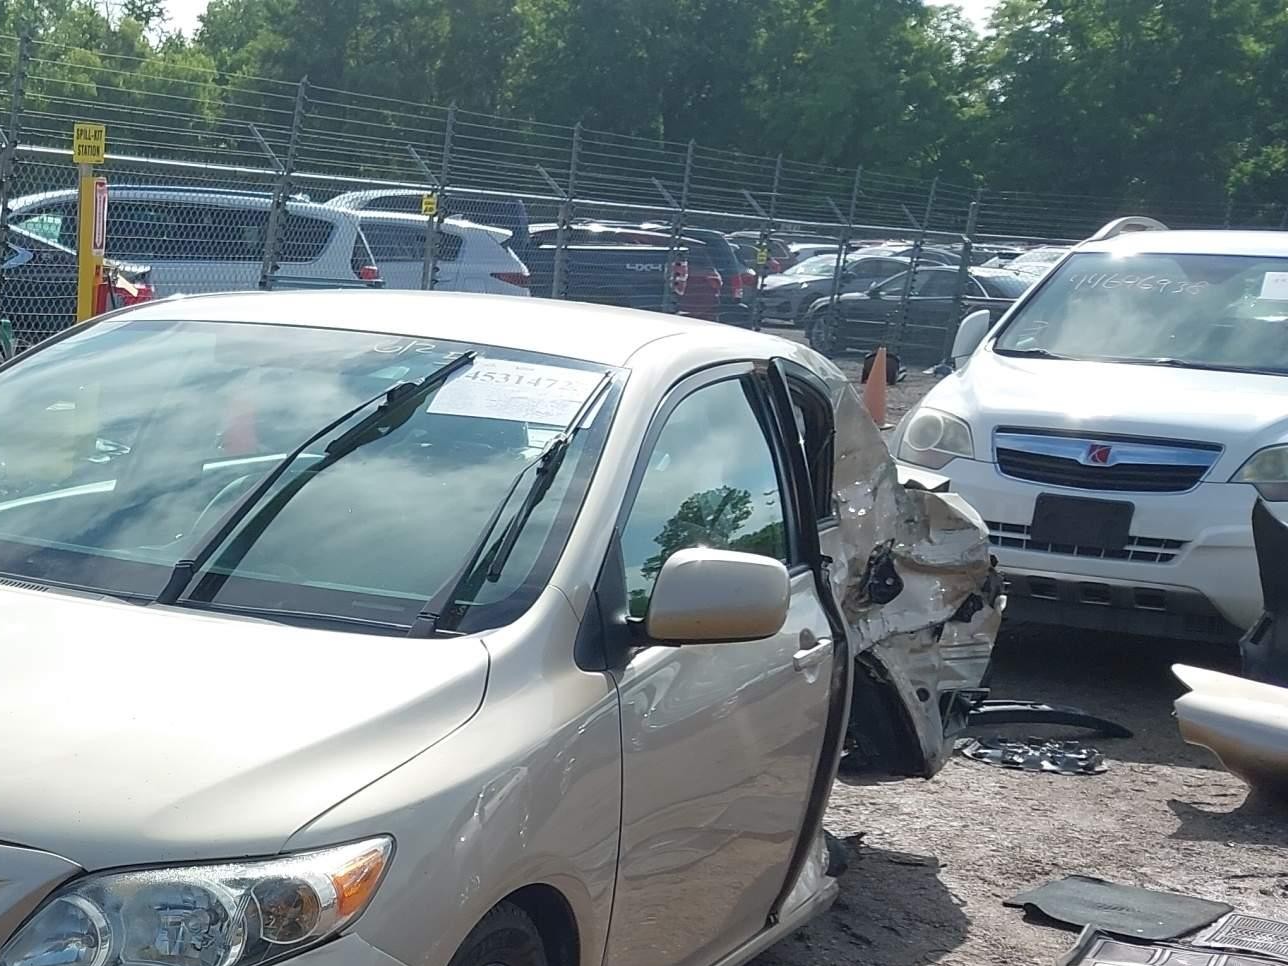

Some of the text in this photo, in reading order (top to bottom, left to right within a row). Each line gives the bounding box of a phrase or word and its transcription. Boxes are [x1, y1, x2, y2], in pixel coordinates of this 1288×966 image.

[76, 128, 103, 141] SPILL-KIT
[77, 144, 101, 156] STATION
[464, 369, 586, 394] 4531472
